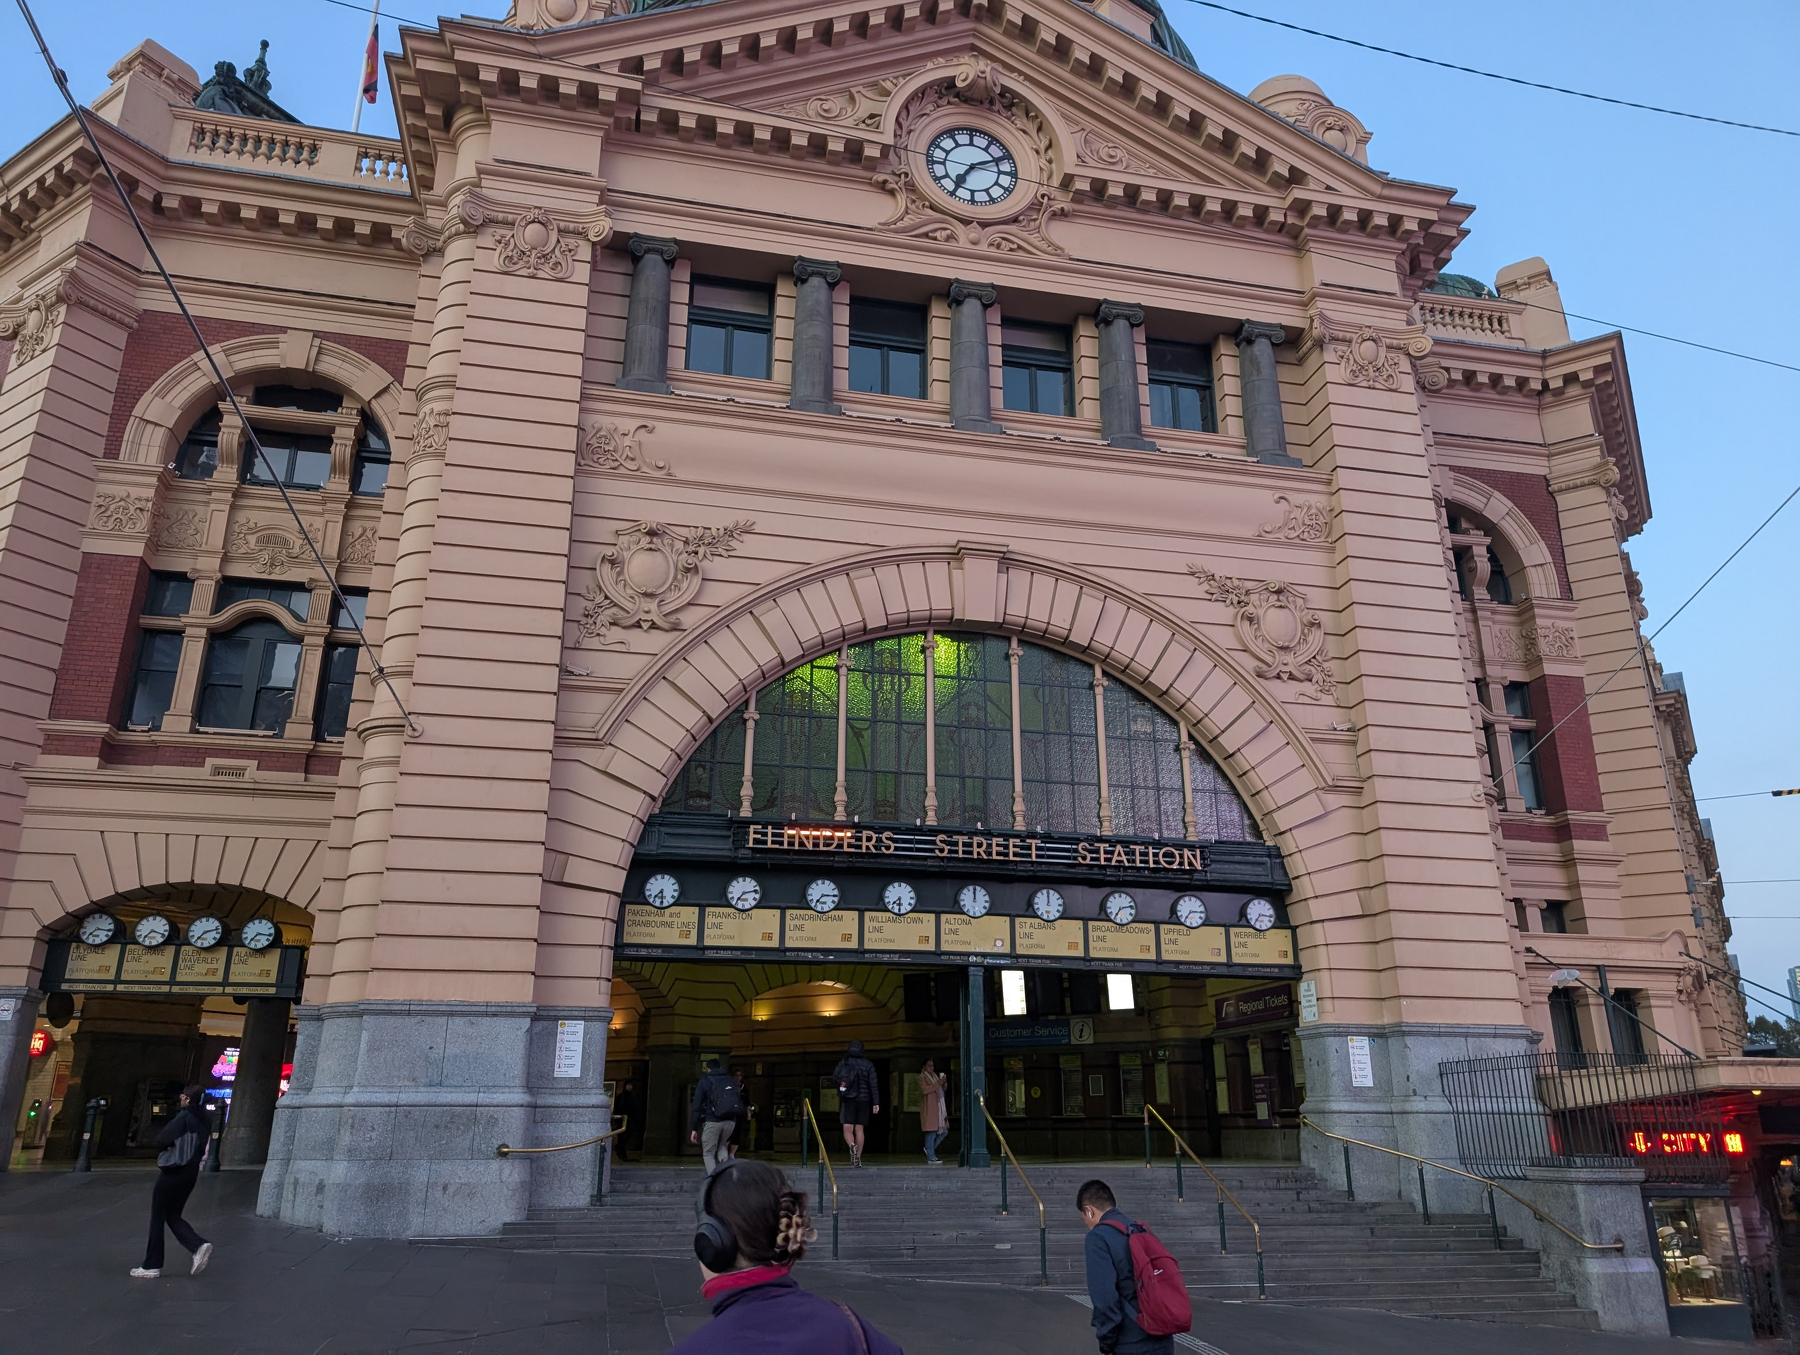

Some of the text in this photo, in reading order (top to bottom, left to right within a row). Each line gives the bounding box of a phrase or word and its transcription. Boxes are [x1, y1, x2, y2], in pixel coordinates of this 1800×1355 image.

[748, 824, 1202, 870] FLINDERS STREET STATION
[627, 908, 666, 918] PAKENHAM
[707, 911, 753, 920] FRANKSTON
[789, 913, 844, 922] SANDRINGHAM
[869, 915, 924, 925] WILLIAMSTOWN
[944, 917, 972, 926] ALTONA
[627, 919, 696, 930] CRANBOURNE LINES
[707, 922, 723, 930] LINE
[789, 924, 805, 932] LINE
[1018, 922, 1056, 931] ST ALBANS
[868, 926, 884, 934] LINE
[944, 928, 960, 936] LINE
[1091, 925, 1150, 935] BROADMEADOWS
[1164, 928, 1191, 937] UPFIELD
[1019, 932, 1034, 940] LINE
[1092, 935, 1108, 943] LINE
[1233, 931, 1267, 940] WERRIBEE
[1164, 938, 1179, 946] LINE
[1233, 941, 1249, 949] LINE
[72, 947, 106, 955] LILYDALE
[127, 948, 166, 956] BELGRAVE
[182, 949, 201, 957] GLEN
[234, 951, 266, 959] ALAMEIN
[126, 955, 143, 963] LINE
[181, 957, 220, 965] WAVERLEY
[233, 958, 249, 966] LINE
[1239, 994, 1288, 1014] Regional Tickets
[989, 1025, 1069, 1038] Customer Service
